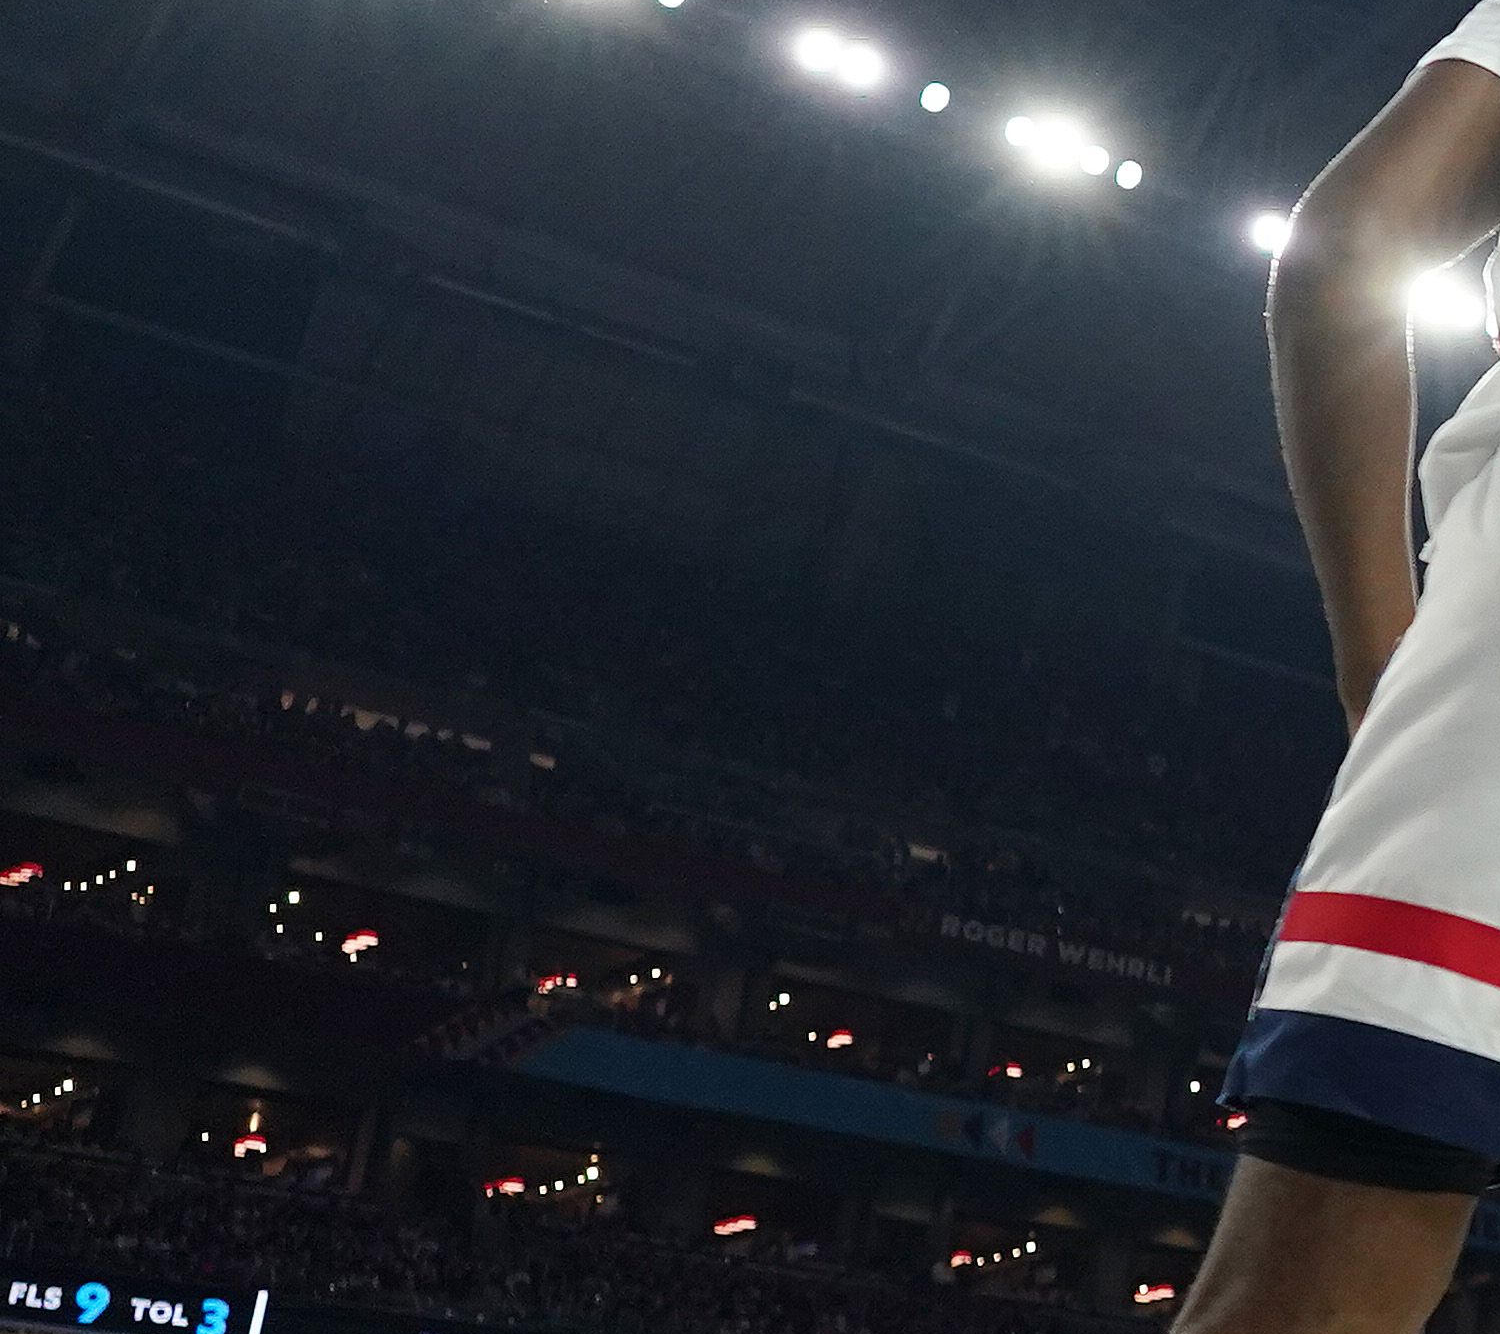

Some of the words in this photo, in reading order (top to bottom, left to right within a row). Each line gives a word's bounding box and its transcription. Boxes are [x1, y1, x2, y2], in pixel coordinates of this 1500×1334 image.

[8, 1282, 62, 1312] FLS
[75, 1282, 110, 1324] 9
[131, 1297, 188, 1328] TOL
